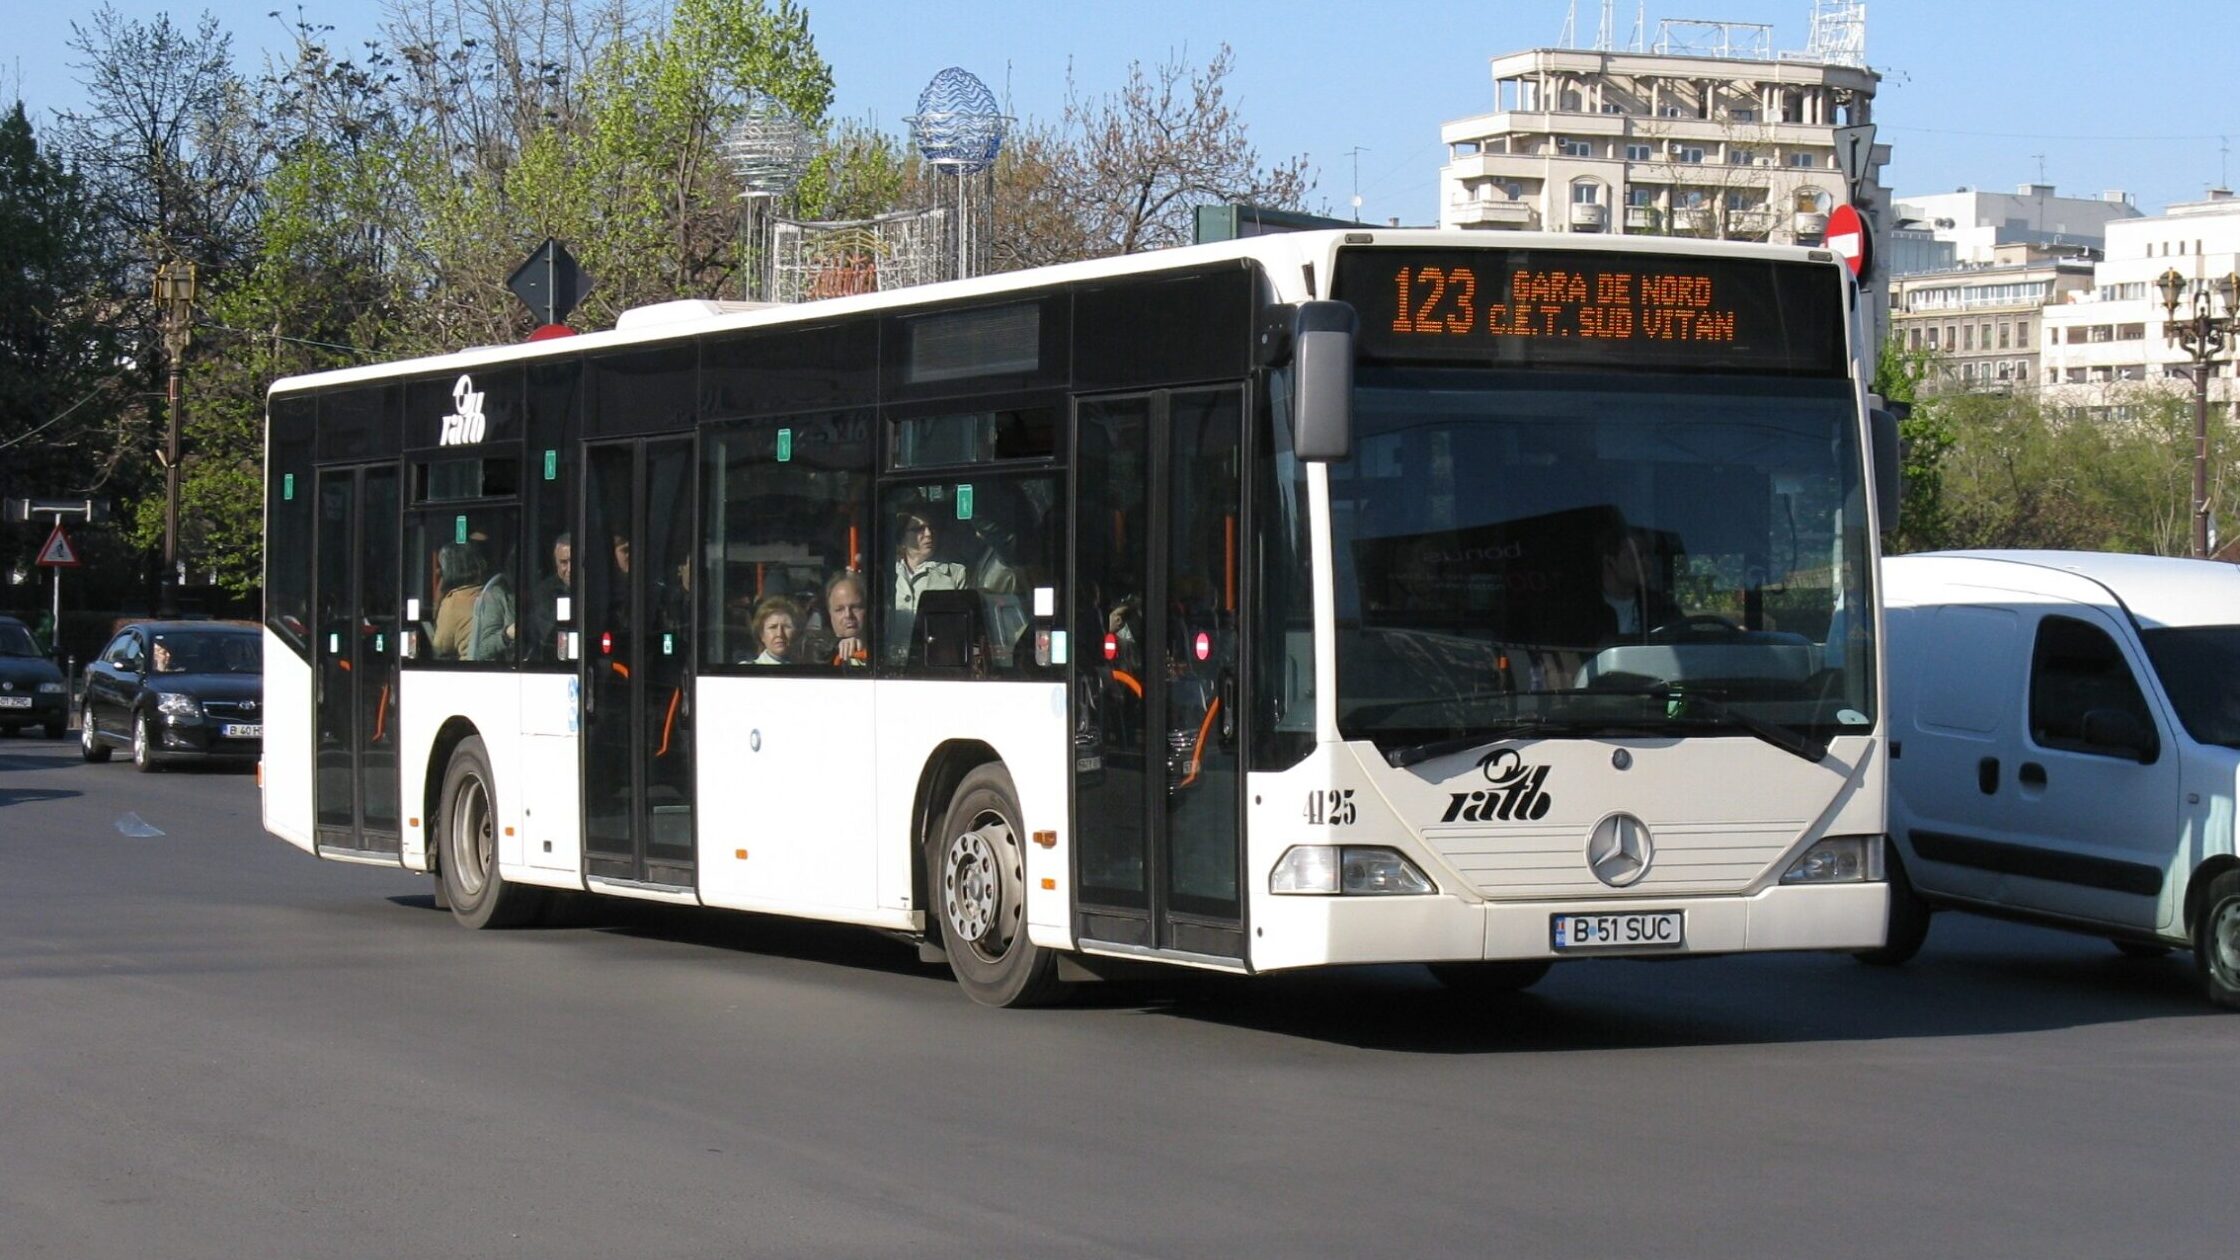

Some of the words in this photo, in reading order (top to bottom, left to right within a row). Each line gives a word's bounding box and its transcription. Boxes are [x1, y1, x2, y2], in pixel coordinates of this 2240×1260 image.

[1393, 267, 1475, 334] 123
[1513, 270, 1586, 302] GARA
[1598, 273, 1631, 304] DE
[1641, 275, 1711, 306] NORD
[1579, 306, 1632, 338] SUD
[1642, 309, 1734, 340] VITAN
[1303, 789, 1356, 825] 4125
[1574, 919, 1589, 942] B
[1597, 918, 1618, 941] 51
[1626, 917, 1671, 941] SUC
